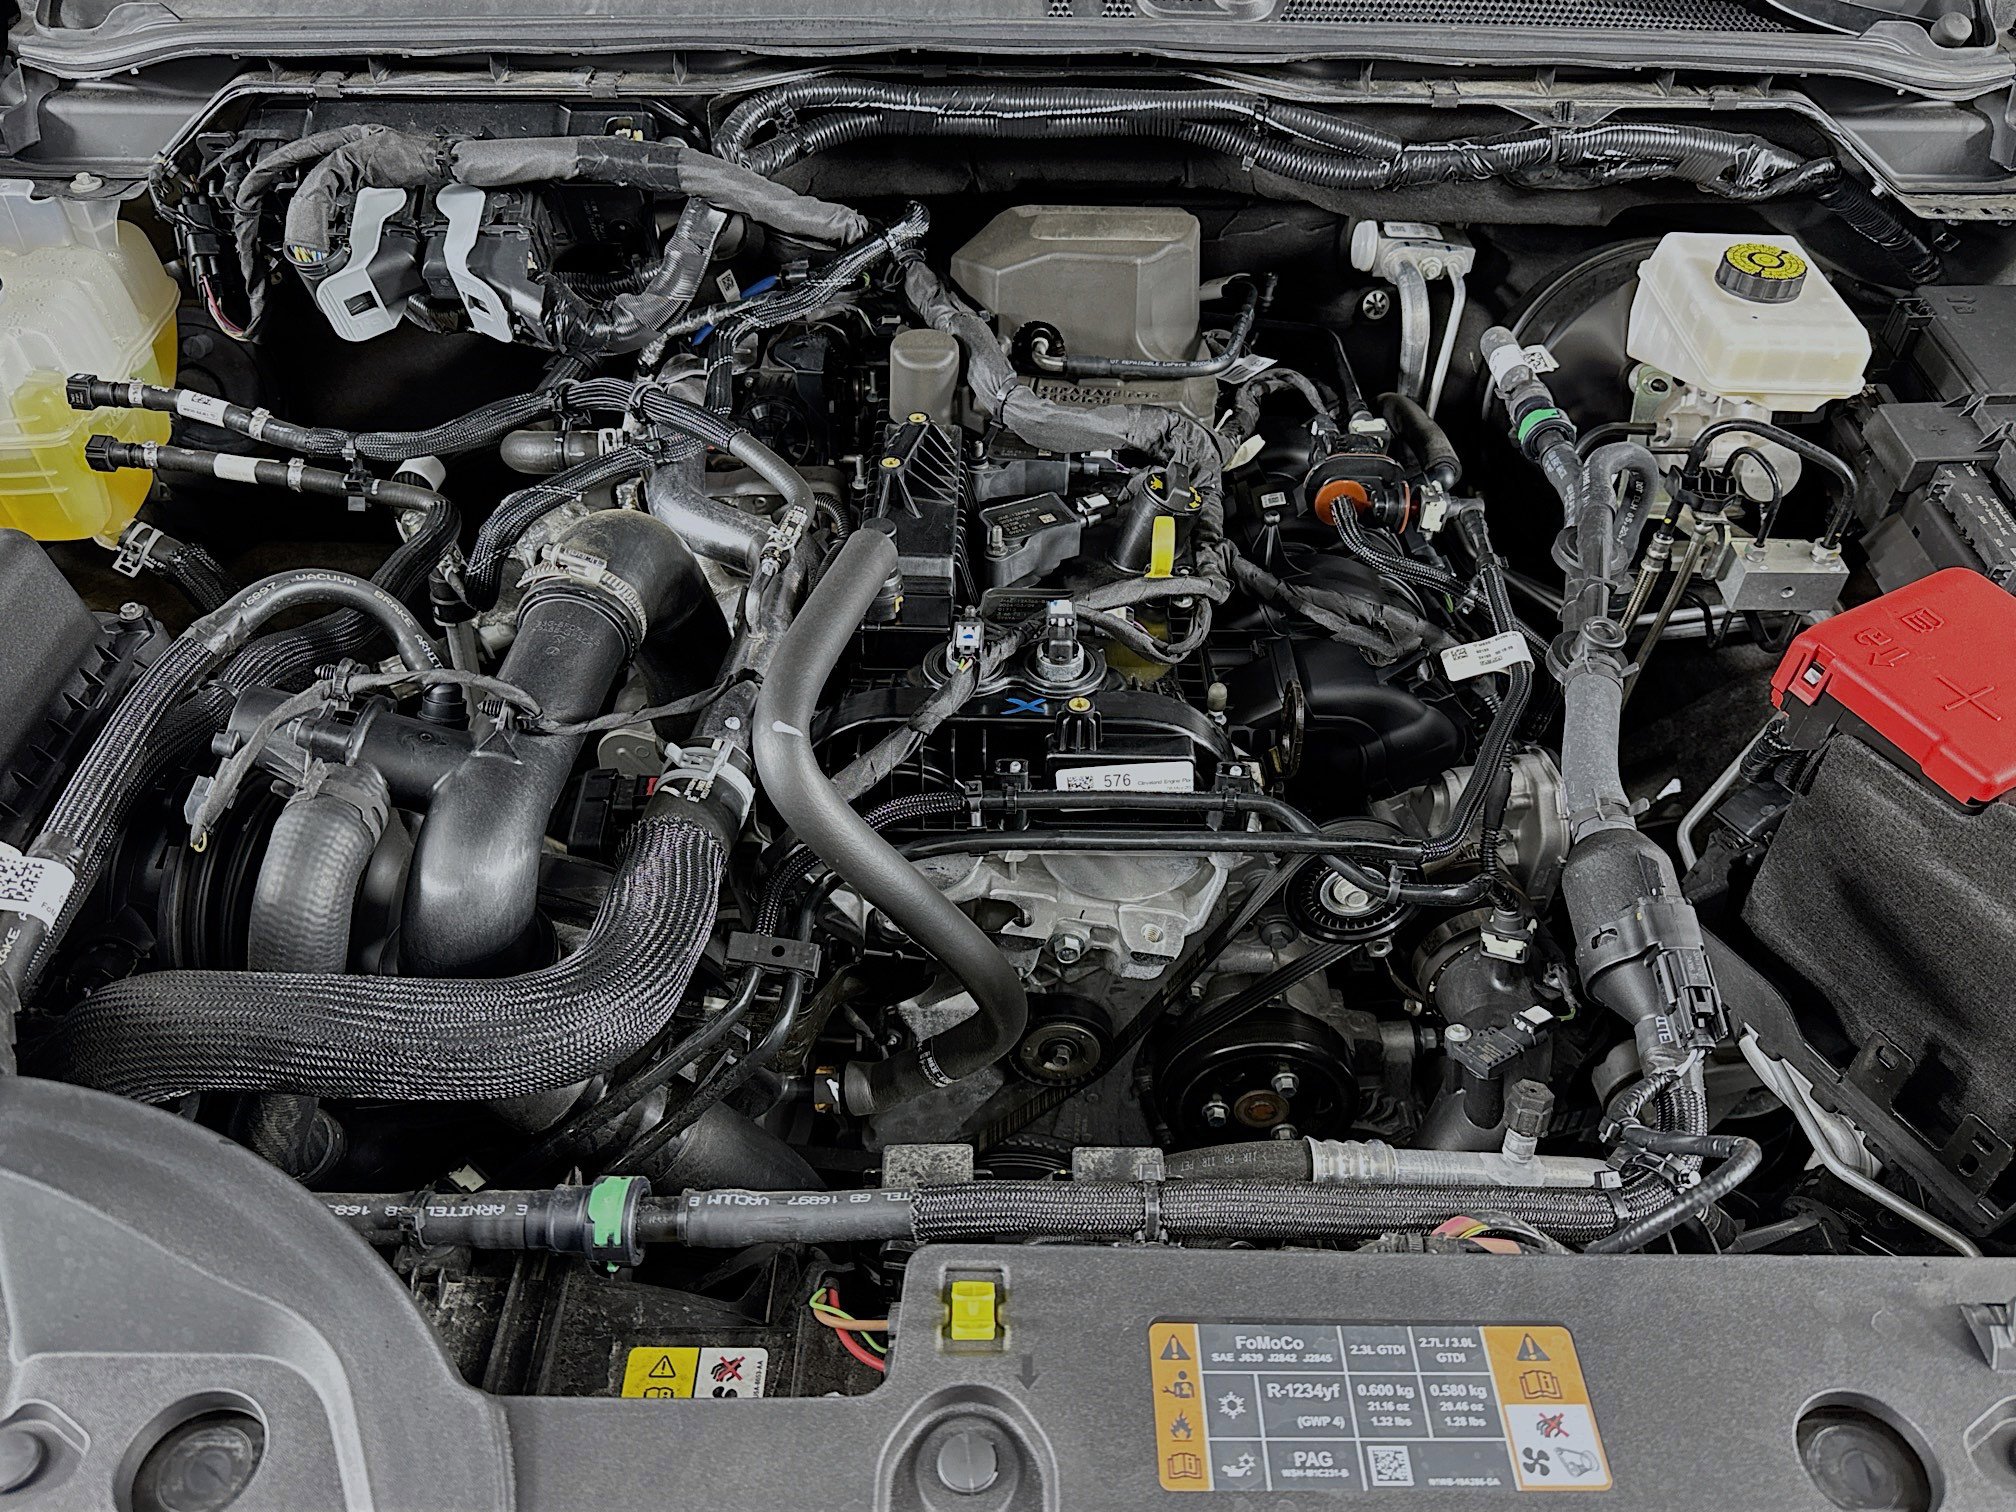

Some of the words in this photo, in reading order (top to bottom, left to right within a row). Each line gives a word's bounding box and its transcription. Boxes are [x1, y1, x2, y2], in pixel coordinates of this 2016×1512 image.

[240, 581, 277, 610] 16897
[295, 573, 358, 587] VACUUM
[372, 589, 415, 629] BRAKE
[413, 633, 444, 670] ARNIT
[1103, 773, 1132, 788] 576
[0, 926, 21, 967] AKE
[707, 1194, 770, 1206] VACUUM
[787, 1195, 838, 1206] 16897
[881, 1191, 913, 1202] TEL
[425, 1204, 507, 1217] ARNITEL
[1235, 1335, 1305, 1350] FoMoCo
[1418, 1337, 1446, 1348] 2.7L
[1349, 1345, 1376, 1355] 2.3L
[1211, 1352, 1236, 1362] SAE
[1238, 1353, 1264, 1363] J639
[1267, 1353, 1298, 1363] J2842
[1302, 1353, 1333, 1363] J2845
[1266, 1382, 1341, 1402] R-1234yf
[1356, 1383, 1395, 1397] 0.600
[1395, 1383, 1415, 1399] kg
[1429, 1383, 1468, 1397] 0.580
[1469, 1383, 1488, 1399] kg
[1367, 1401, 1396, 1411] 21.16
[1396, 1402, 1411, 1411] oz
[1439, 1401, 1469, 1411] 20.46
[1470, 1402, 1485, 1411] oz
[1296, 1415, 1332, 1430] (GWP
[1331, 1415, 1346, 1430] 4)
[1370, 1416, 1394, 1427] 1.32
[1394, 1416, 1413, 1427] lbs
[1444, 1416, 1468, 1427] 1.28
[1468, 1416, 1487, 1427] lbs
[1293, 1450, 1334, 1467] PAG
